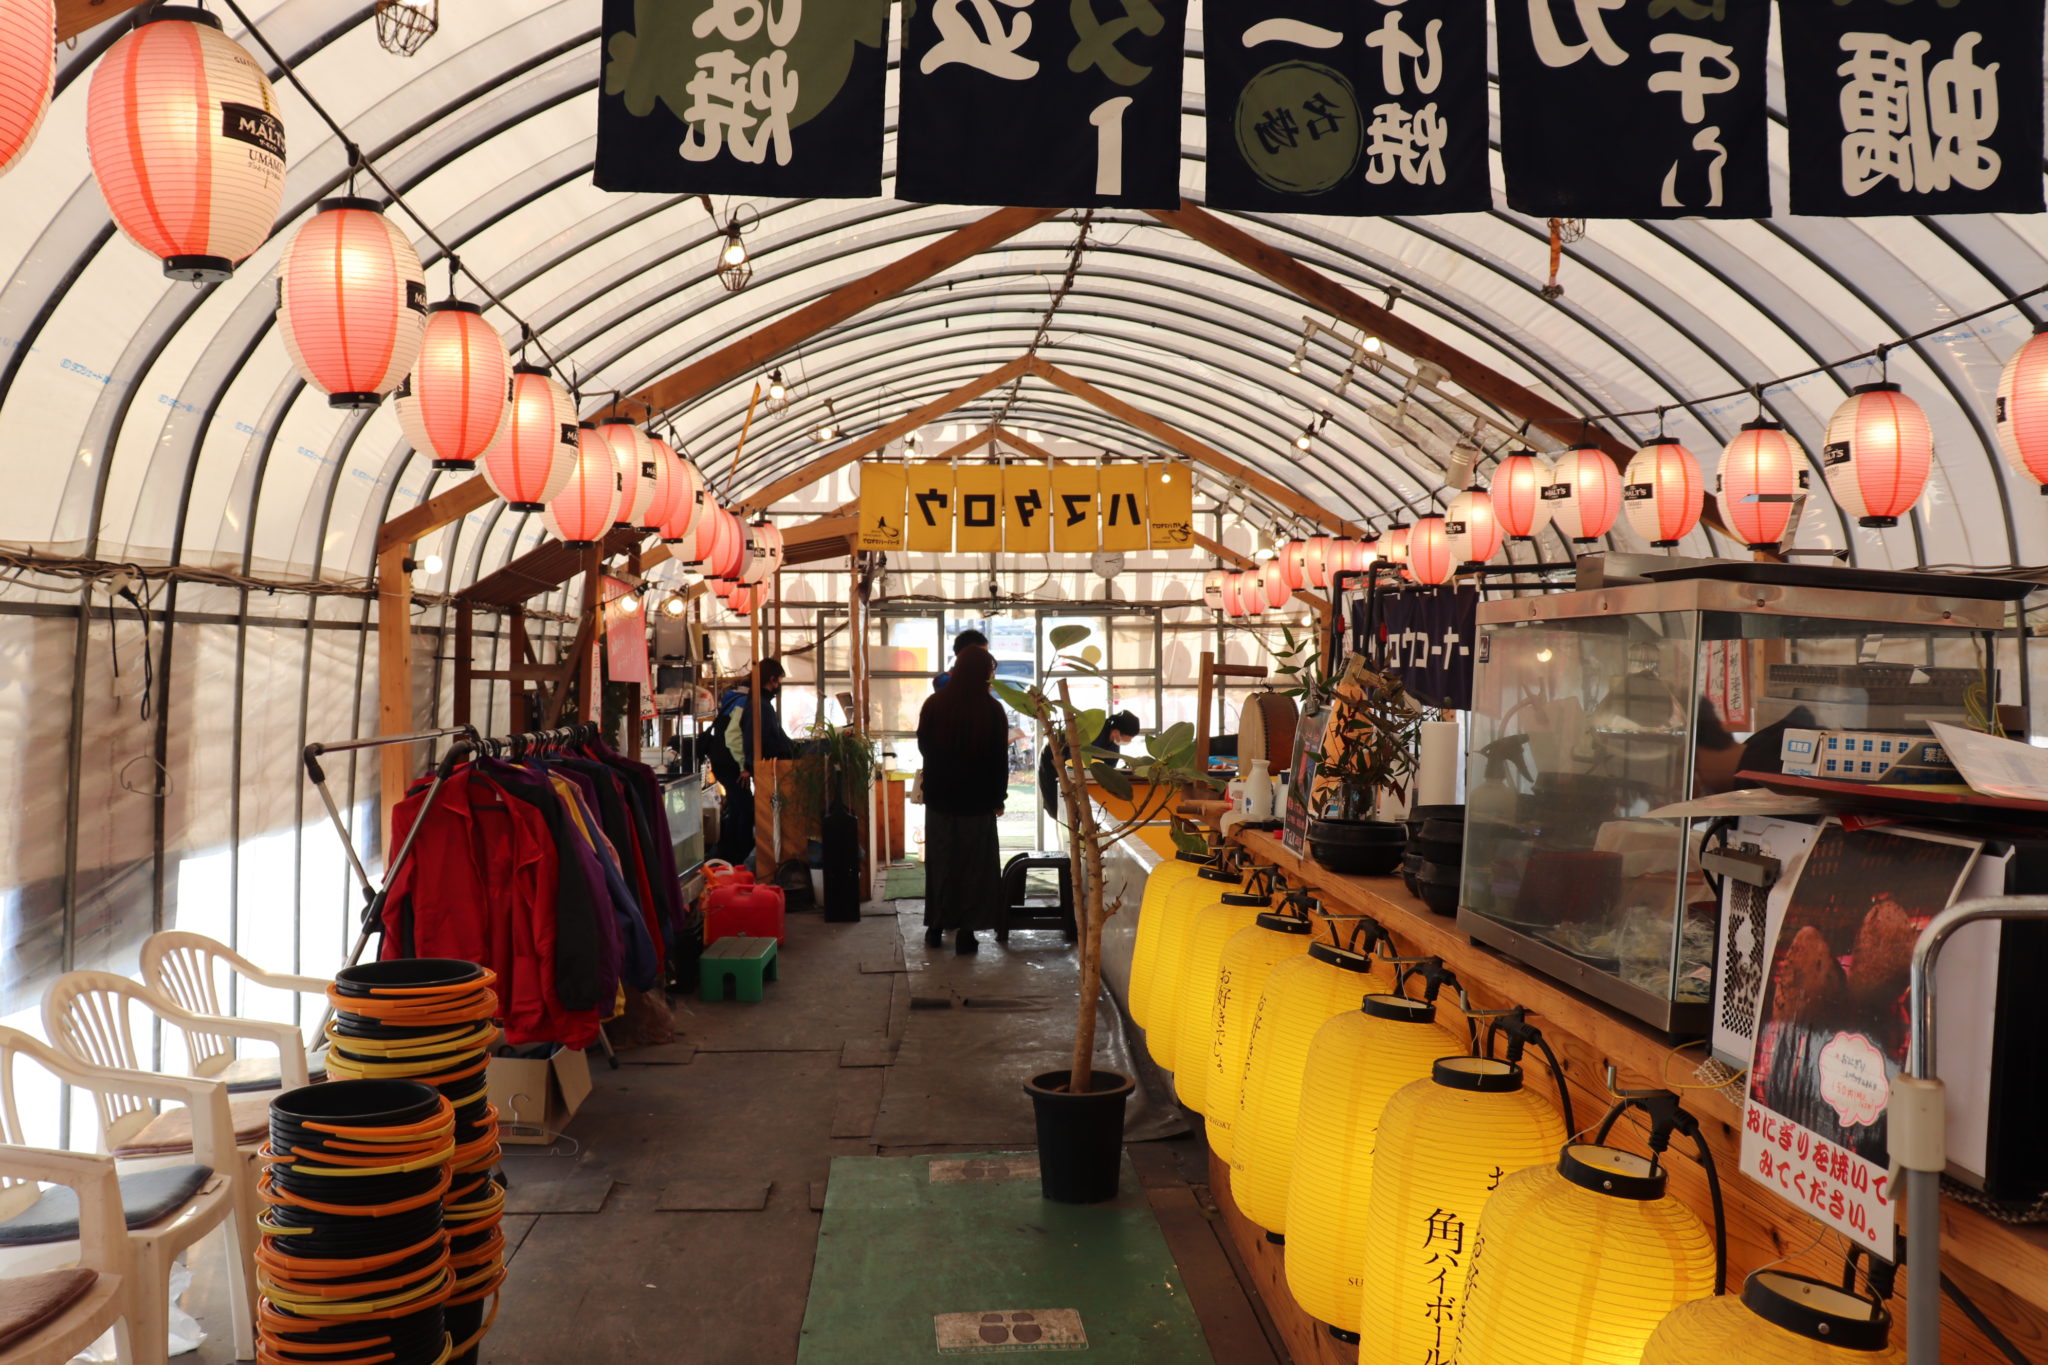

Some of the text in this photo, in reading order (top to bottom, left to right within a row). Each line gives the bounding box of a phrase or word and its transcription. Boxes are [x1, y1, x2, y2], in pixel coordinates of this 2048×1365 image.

[1746, 1103, 1889, 1207] おにぎりを焼いて
[1758, 1149, 1878, 1242] みてください。
[1421, 1207, 1466, 1365] 角ハイボール
